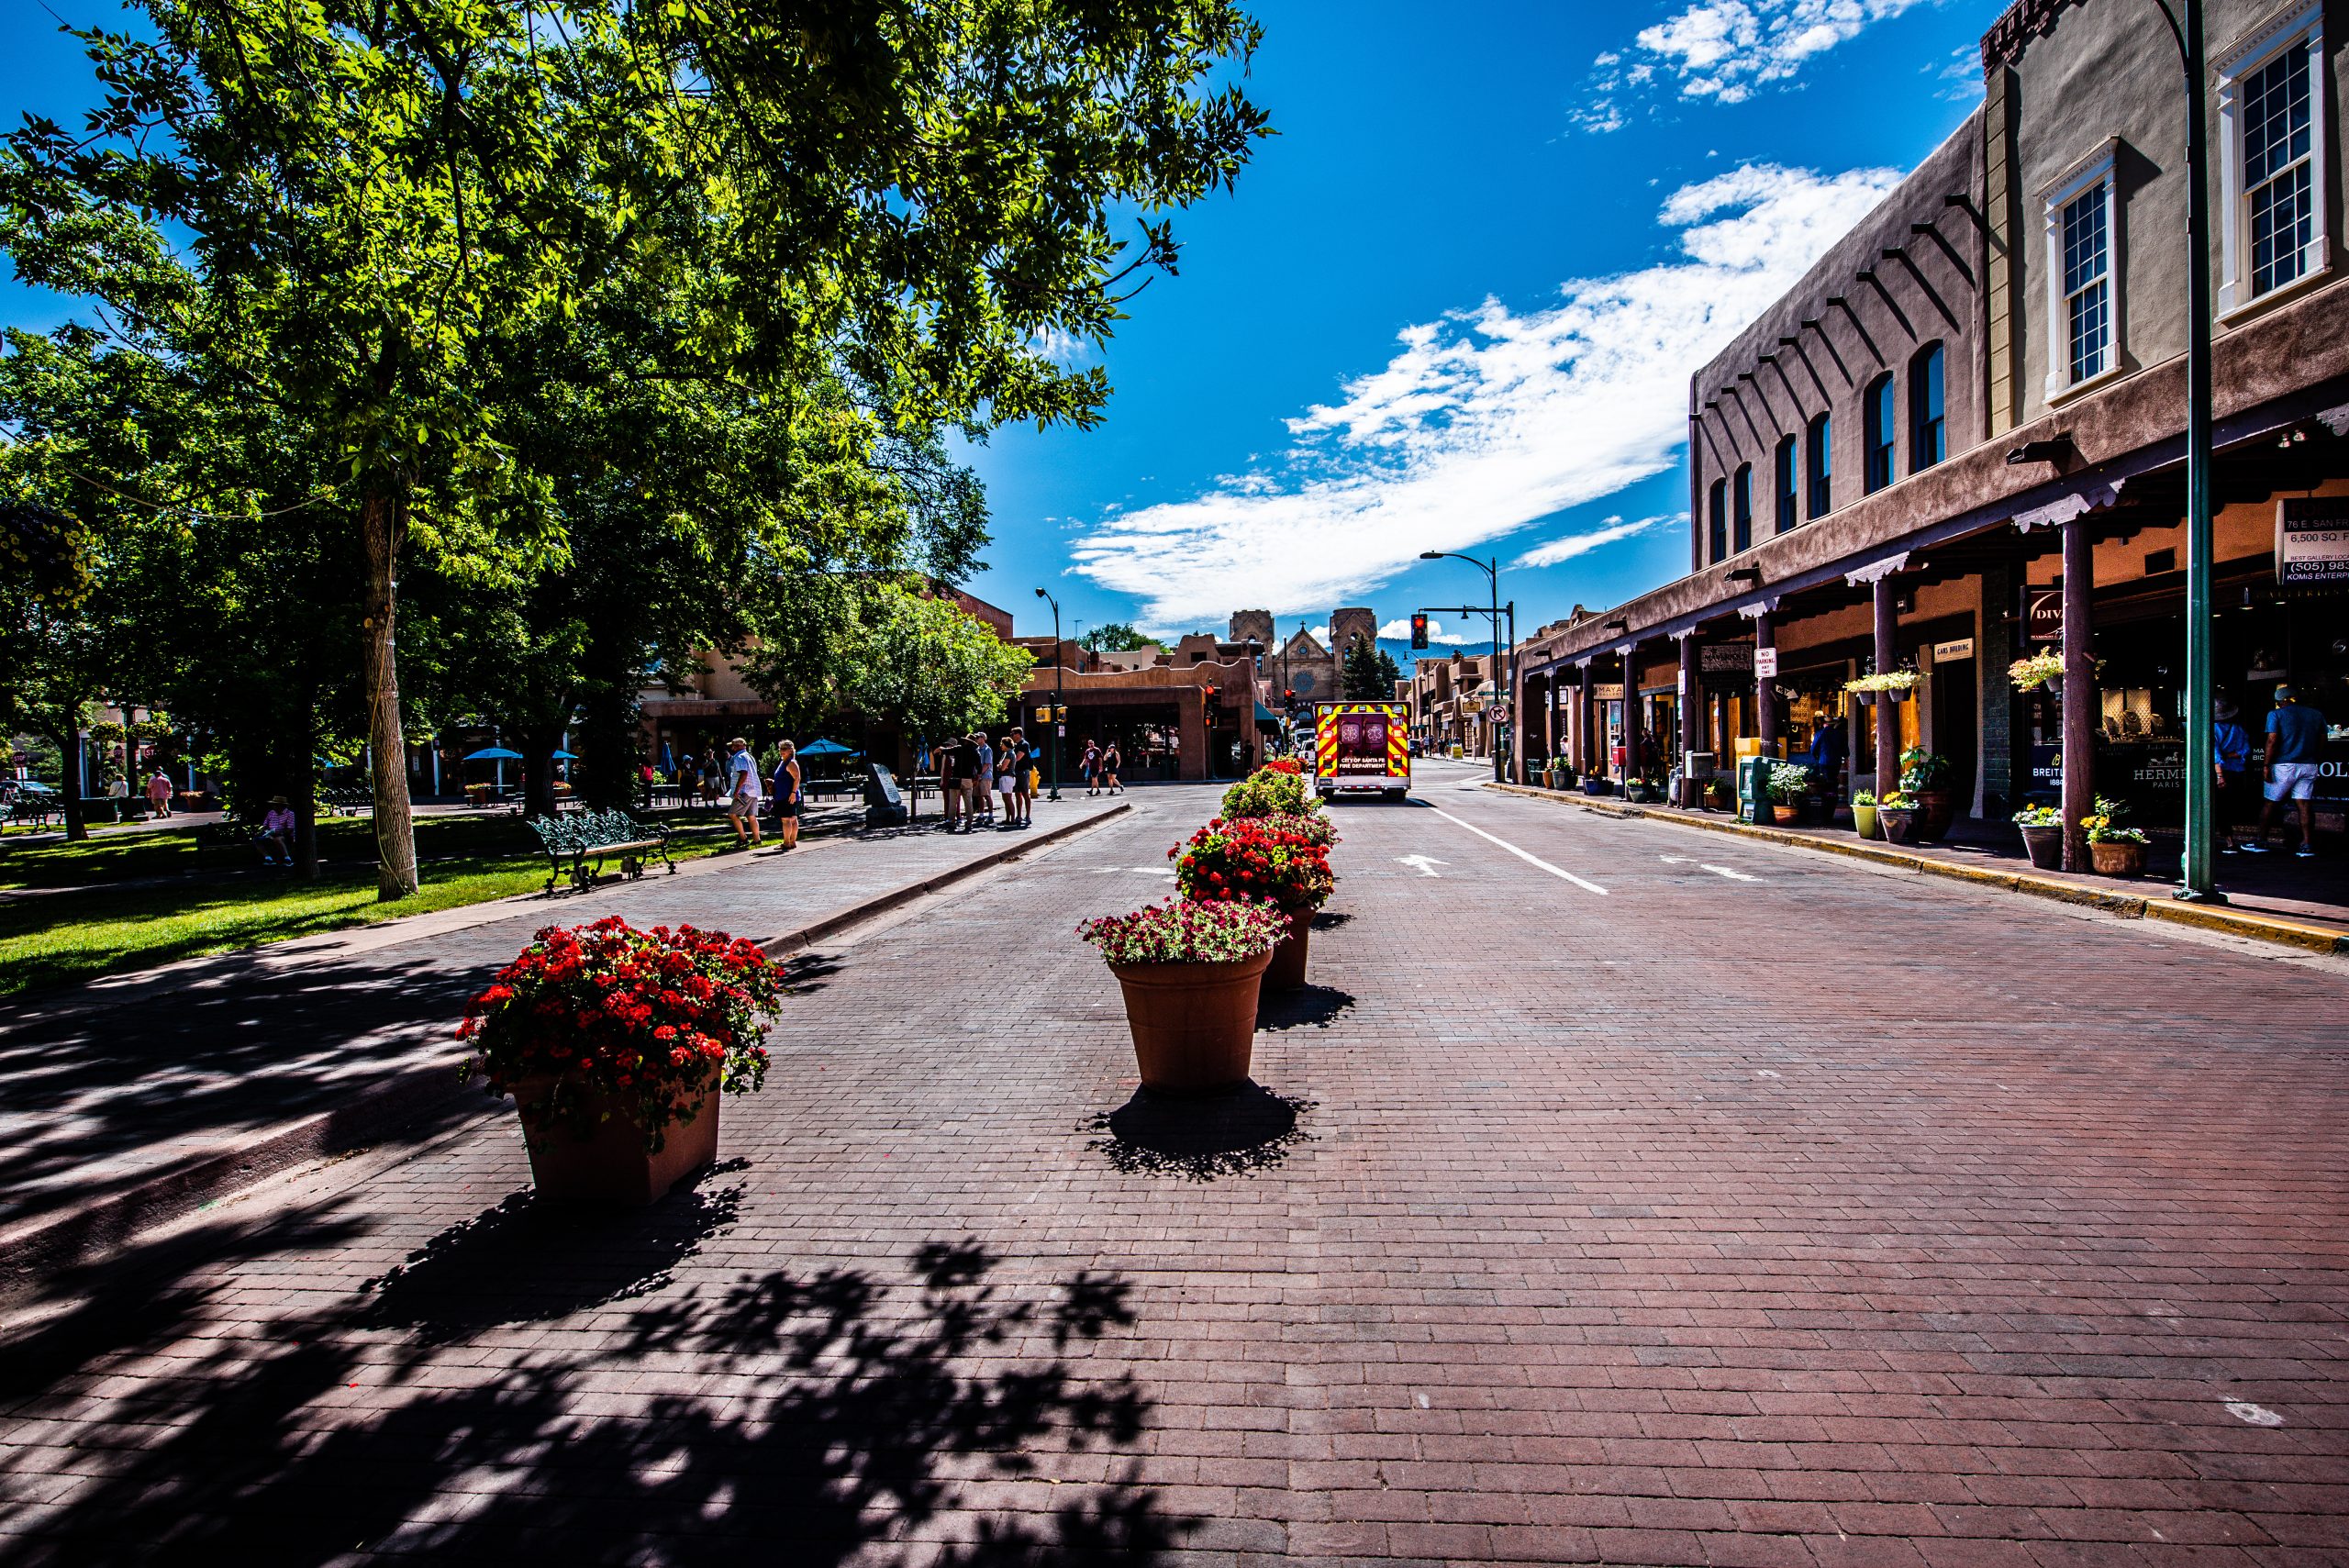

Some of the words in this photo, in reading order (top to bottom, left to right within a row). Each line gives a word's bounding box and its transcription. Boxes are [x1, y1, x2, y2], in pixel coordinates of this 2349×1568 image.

[2287, 520, 2299, 528] 76
[2313, 519, 2333, 528] SAN
[2336, 518, 2349, 527] FR
[2290, 534, 2319, 543] 6,500
[2321, 532, 2340, 541] SQ.
[2290, 562, 2325, 573] (505)
[2328, 562, 2349, 571] 983
[2036, 609, 2063, 619] DIV
[1949, 643, 1969, 653] BUILDING
[1393, 717, 1403, 726] M1
[2032, 768, 2063, 776] BREITL
